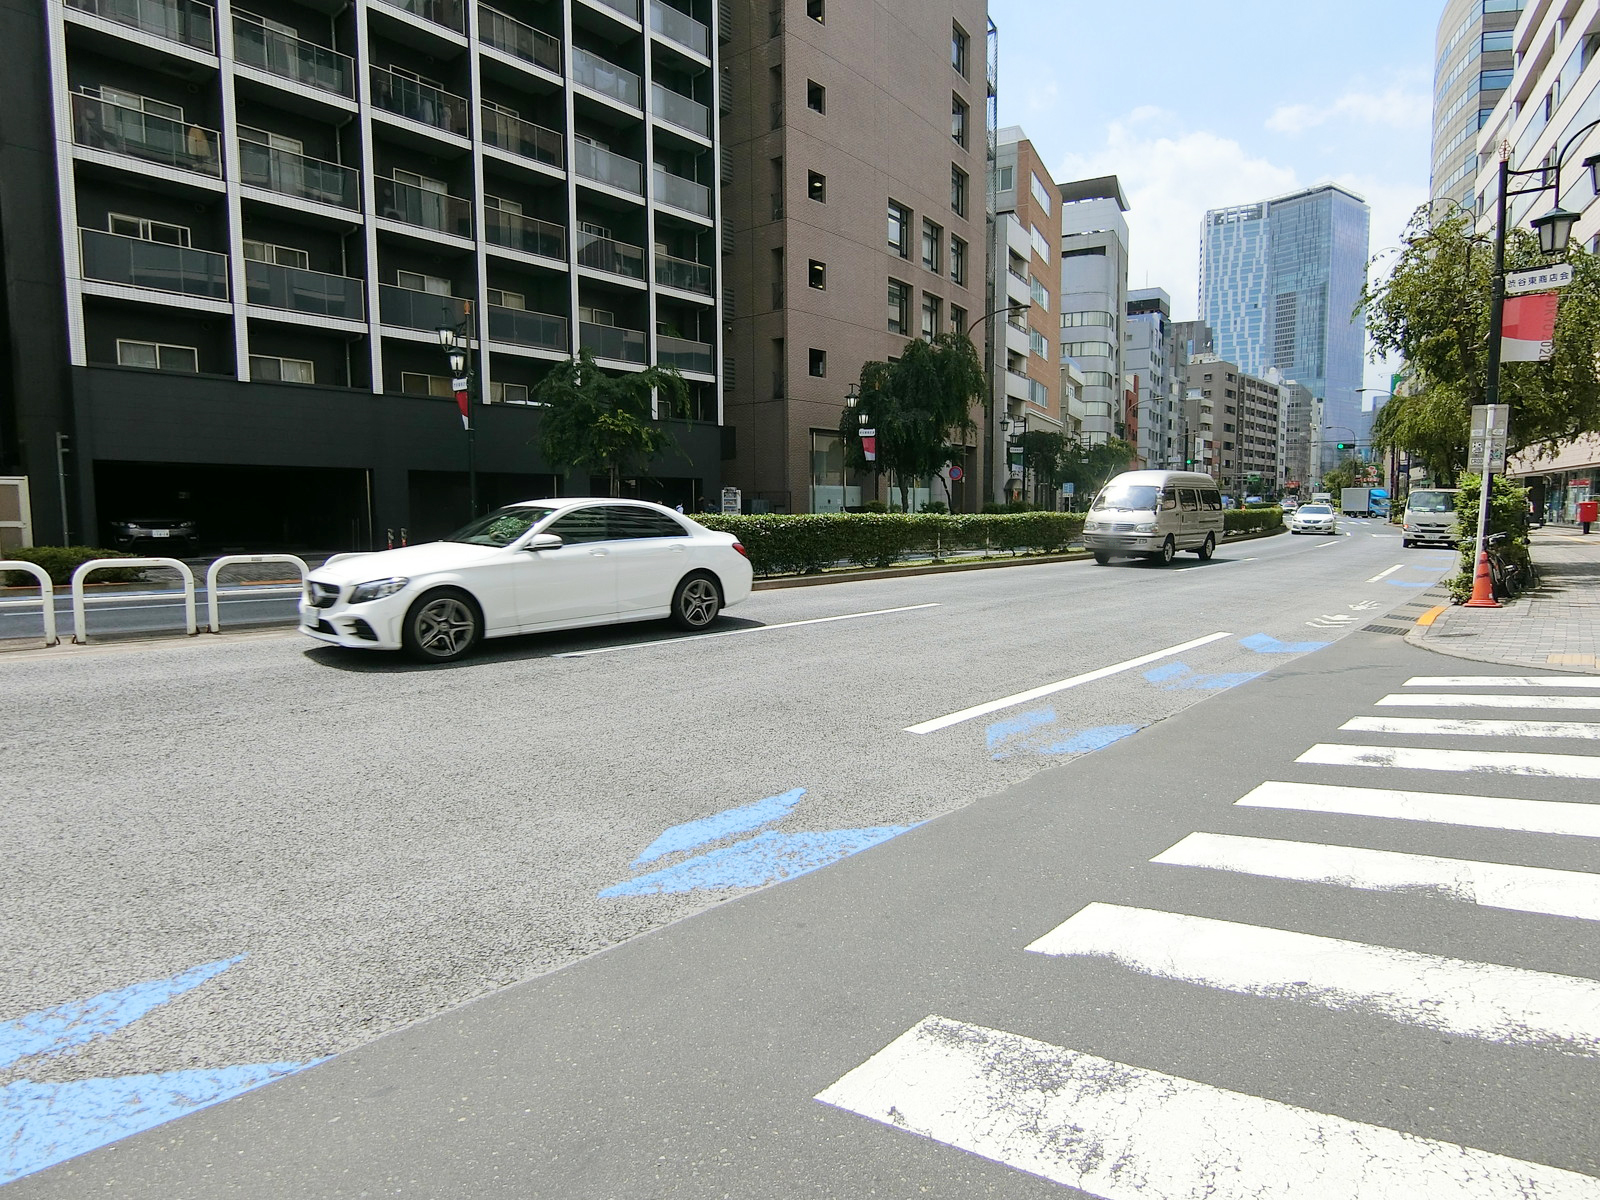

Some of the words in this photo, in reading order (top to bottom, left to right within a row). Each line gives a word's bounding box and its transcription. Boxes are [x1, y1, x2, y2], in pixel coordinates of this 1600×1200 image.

[1507, 271, 1569, 288] 渋谷東商店会
[1543, 296, 1556, 331] OKYO
[1538, 334, 1553, 361] 2020
